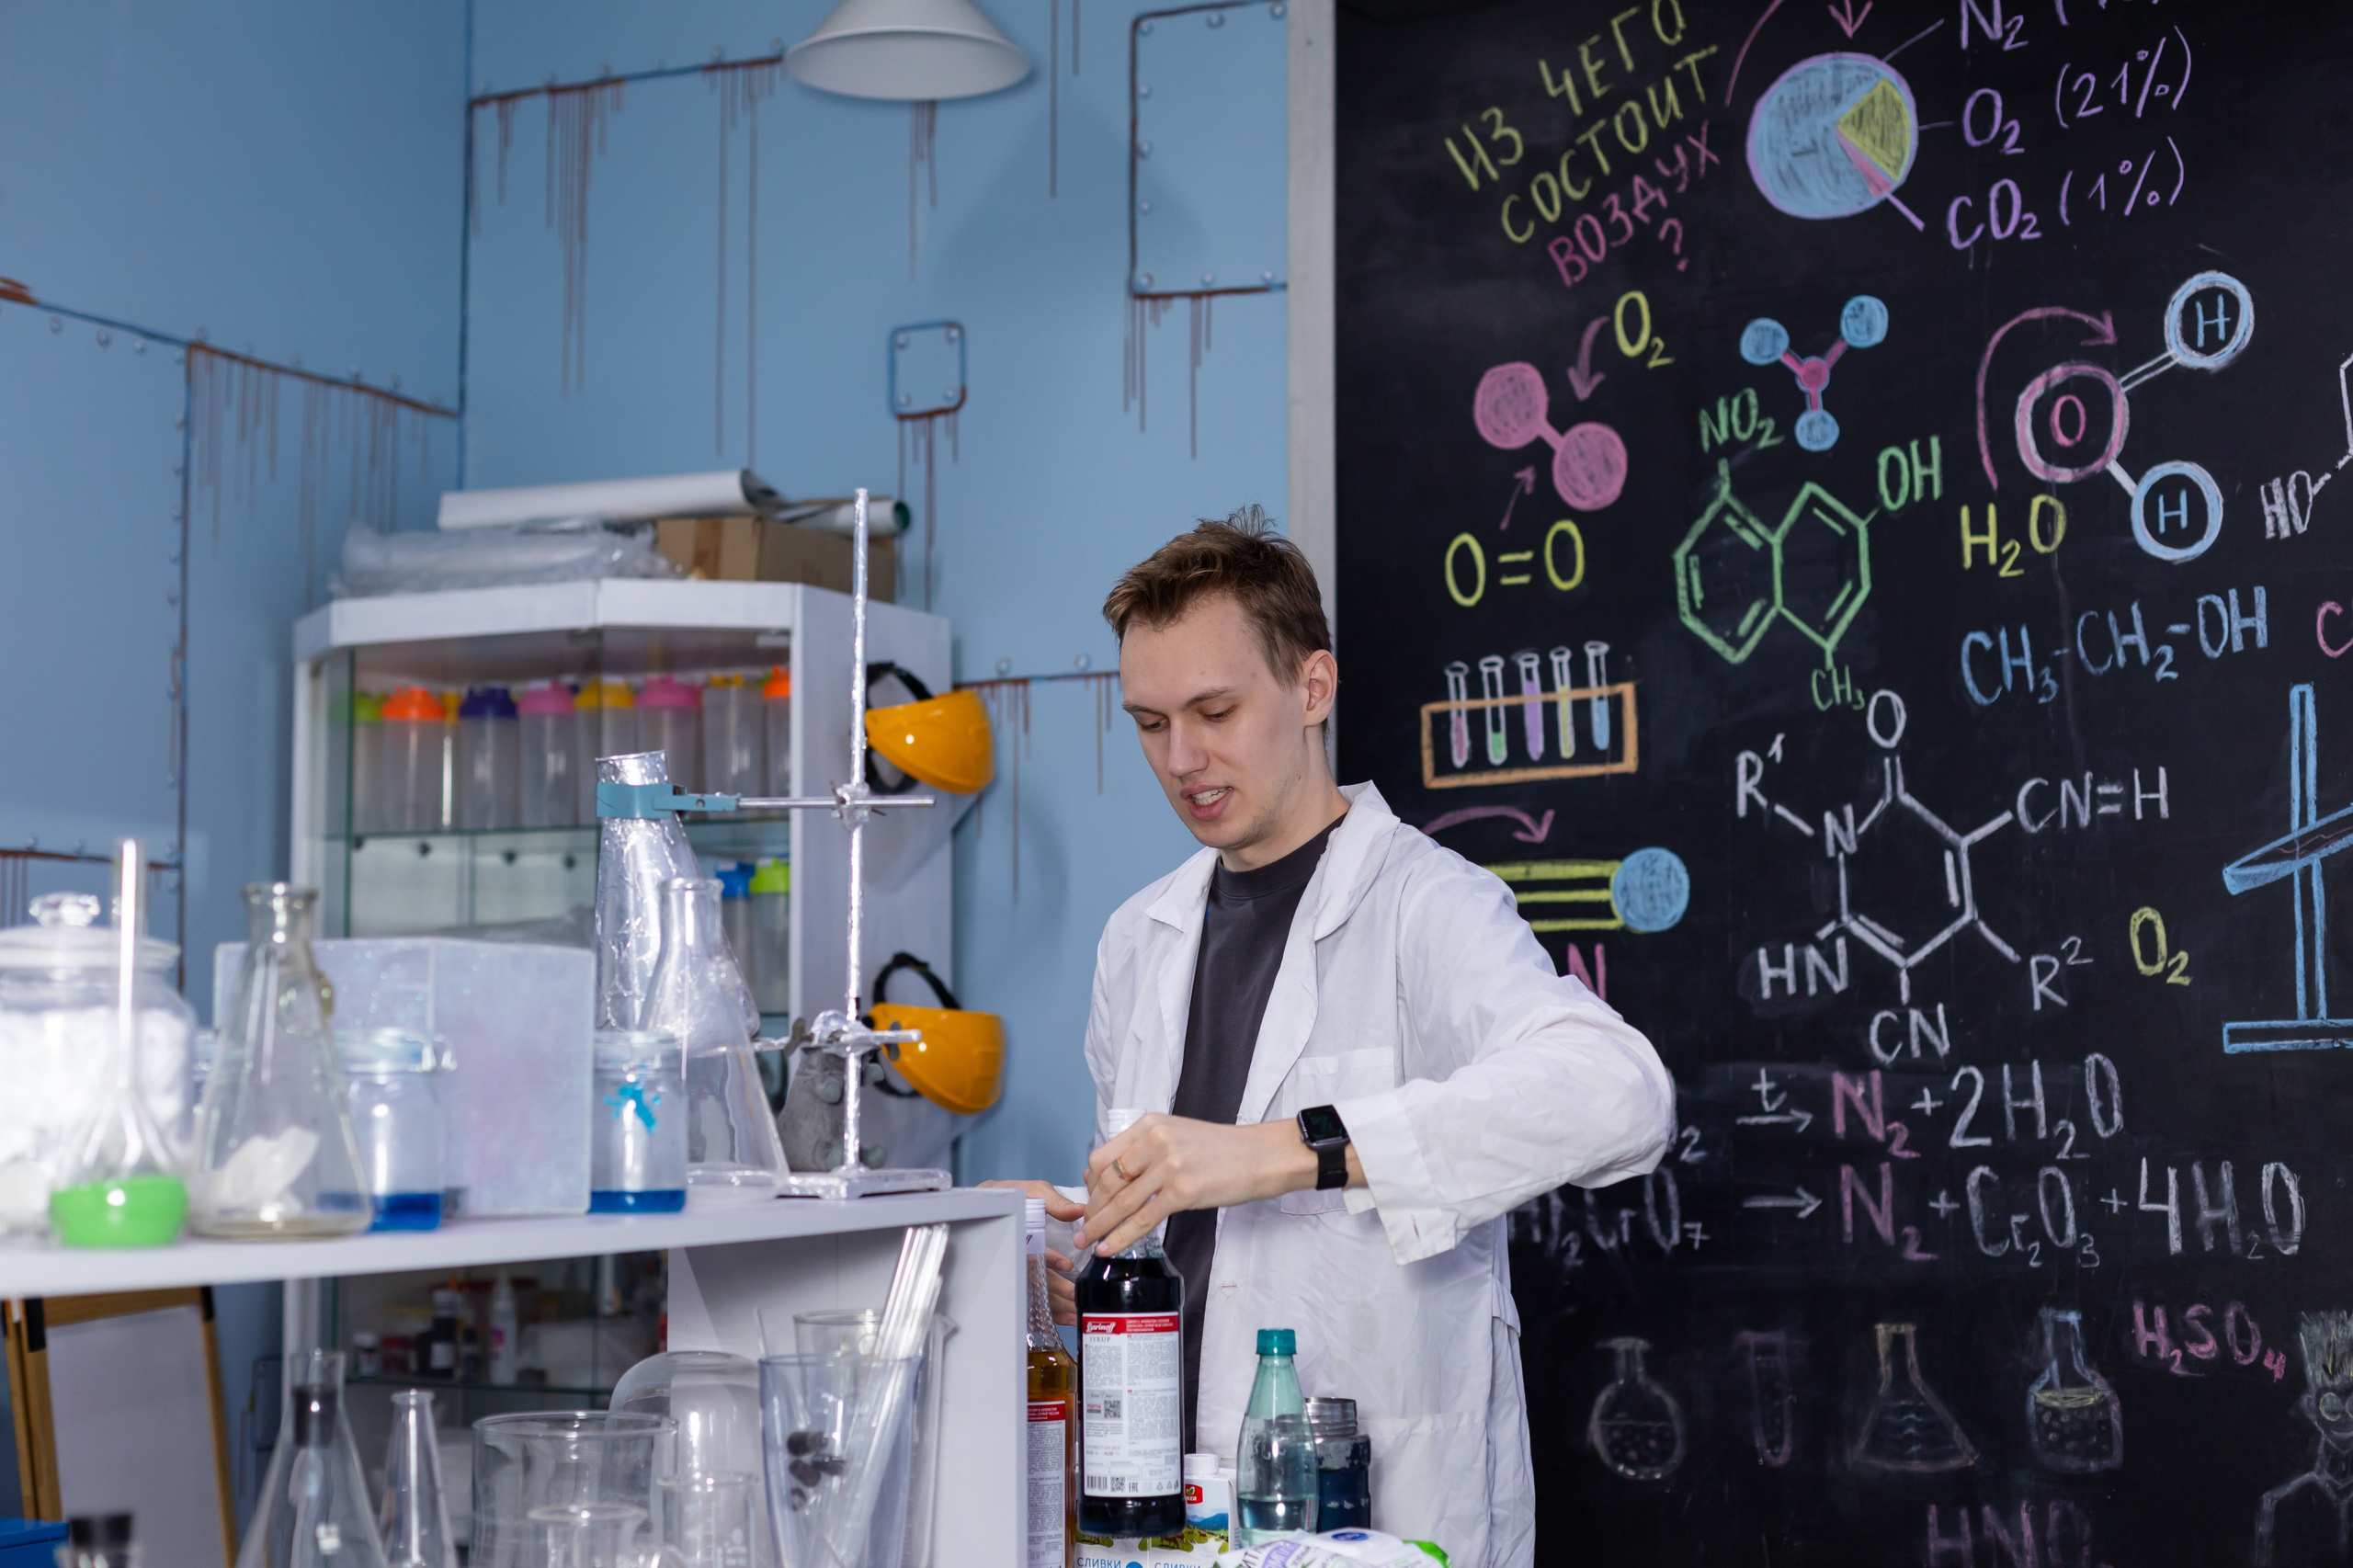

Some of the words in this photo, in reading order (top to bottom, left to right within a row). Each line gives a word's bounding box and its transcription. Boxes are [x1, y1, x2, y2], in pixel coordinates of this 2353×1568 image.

[1445, 107, 1523, 191] ИЗ
[1540, 0, 1687, 116] ЧЕГО
[1963, 88, 2024, 154] O2
[2056, 25, 2192, 129] (21%)
[1501, 45, 1718, 243] СОСТОИТ
[1548, 119, 1721, 287] ВОЗДУХ
[1948, 178, 2041, 249] CO2
[2060, 136, 2184, 226] (1%)
[1614, 290, 1675, 369] O2
[2196, 294, 2231, 348] H
[1699, 388, 1784, 453] NO2
[2050, 394, 2086, 448] O
[1878, 436, 1941, 511] OH
[1960, 494, 2067, 577] H2O
[2158, 489, 2188, 534] H
[1811, 664, 1866, 711] CH3
[1867, 688, 1907, 749] O
[1824, 802, 1858, 858] N
[1758, 936, 1848, 1000] HN
[2129, 906, 2193, 986] O2
[1869, 1003, 1950, 1064] CN
[2132, 1300, 2287, 1382] H2SO4
